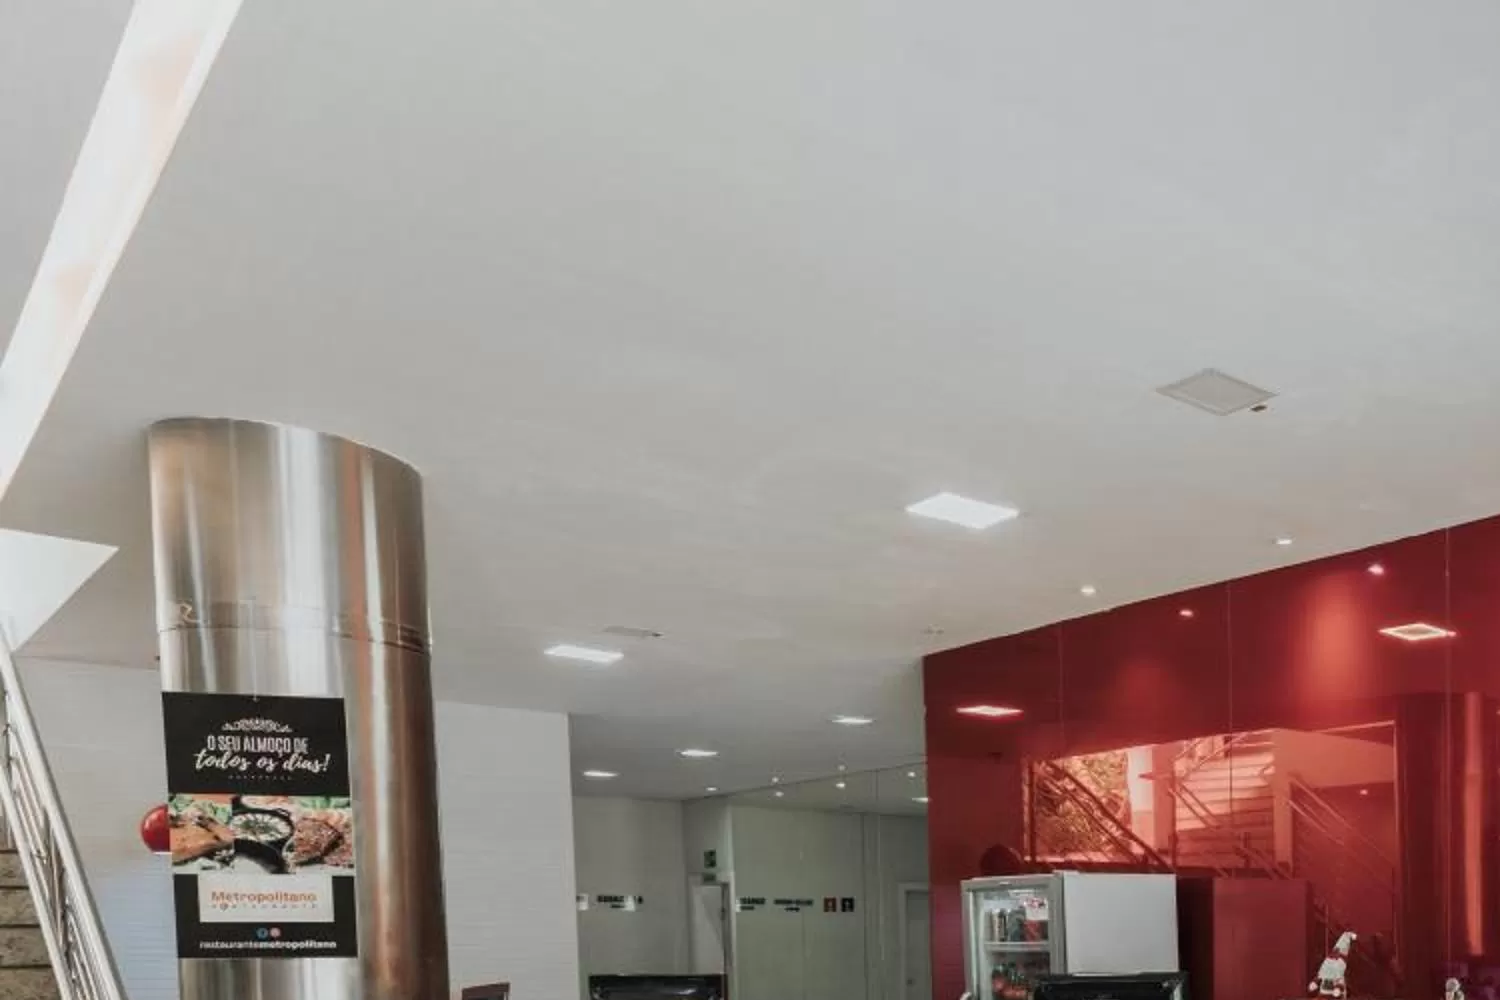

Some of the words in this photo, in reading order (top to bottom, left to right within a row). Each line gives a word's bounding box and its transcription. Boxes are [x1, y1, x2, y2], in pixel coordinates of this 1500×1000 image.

[207, 735, 216, 751] O
[217, 735, 241, 752] SEU
[243, 736, 291, 757] ALMOÇO
[293, 737, 309, 754] DE
[193, 748, 251, 771] todos
[256, 756, 279, 772] os
[282, 752, 332, 773] dias!
[211, 891, 318, 904] Metropolitano
[199, 939, 337, 950] restaurantemetropolitano
